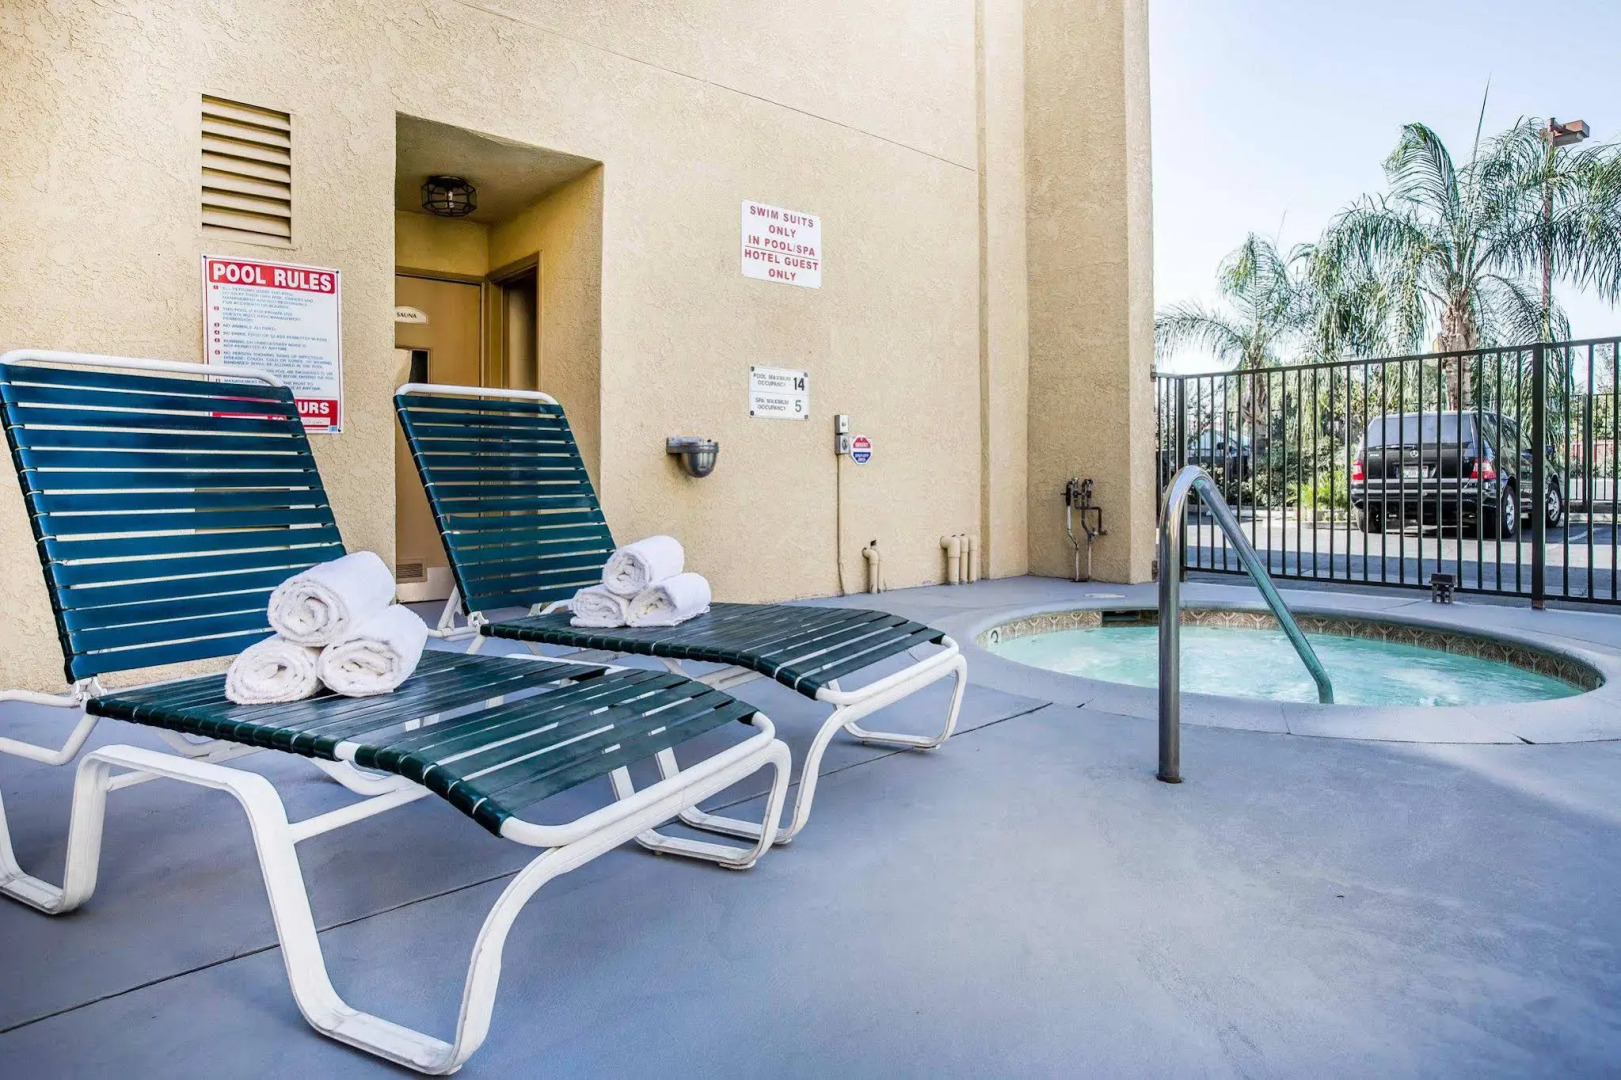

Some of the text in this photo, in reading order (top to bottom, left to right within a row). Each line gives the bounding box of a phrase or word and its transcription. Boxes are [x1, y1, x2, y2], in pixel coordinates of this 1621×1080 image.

[750, 205, 814, 228] SWIM SUITS
[769, 224, 796, 238] ONLY
[748, 235, 815, 256] IN POOL/SPA
[744, 249, 818, 271] HOTEL GUEST
[213, 263, 332, 292] POOL RULES
[768, 268, 796, 281] ONLY
[794, 377, 805, 391] 14
[297, 401, 330, 414] URS
[795, 400, 801, 412] 5
